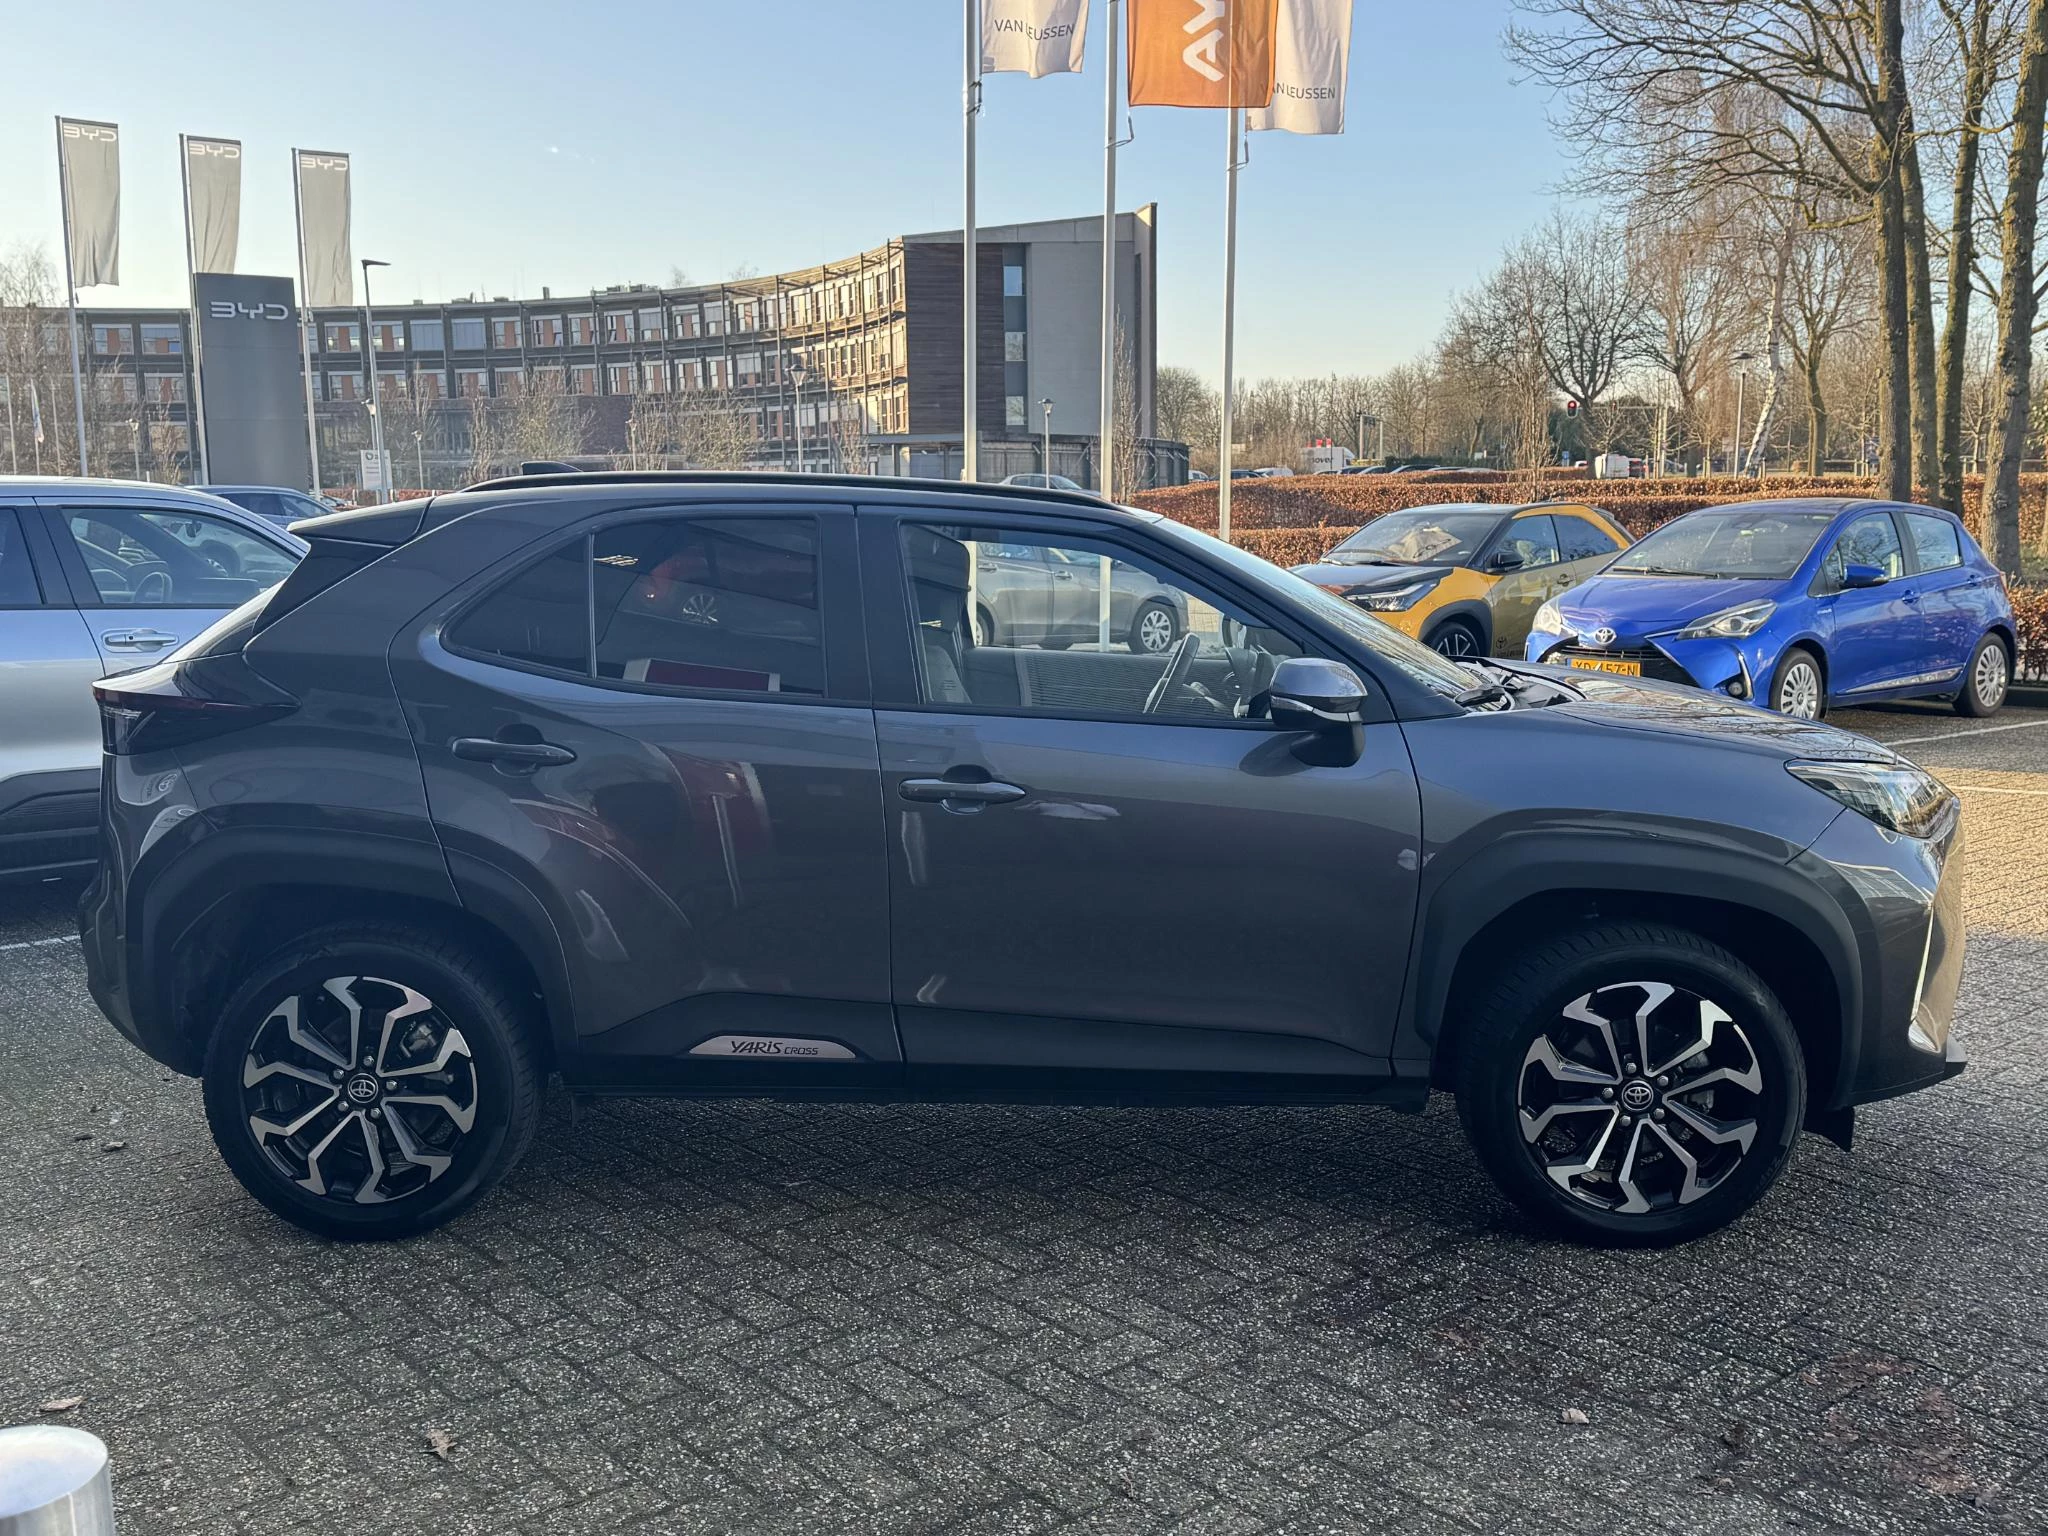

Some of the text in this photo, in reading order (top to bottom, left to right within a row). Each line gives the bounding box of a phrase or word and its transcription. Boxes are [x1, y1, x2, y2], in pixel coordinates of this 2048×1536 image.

[994, 19, 1075, 40] VAN LEUSSEN
[1286, 84, 1336, 99] LEUSSEN
[63, 125, 117, 141] BYD
[189, 143, 239, 158] BYD
[300, 156, 348, 171] BYD
[211, 301, 288, 320] BYD
[784, 1046, 819, 1056] CROSS
